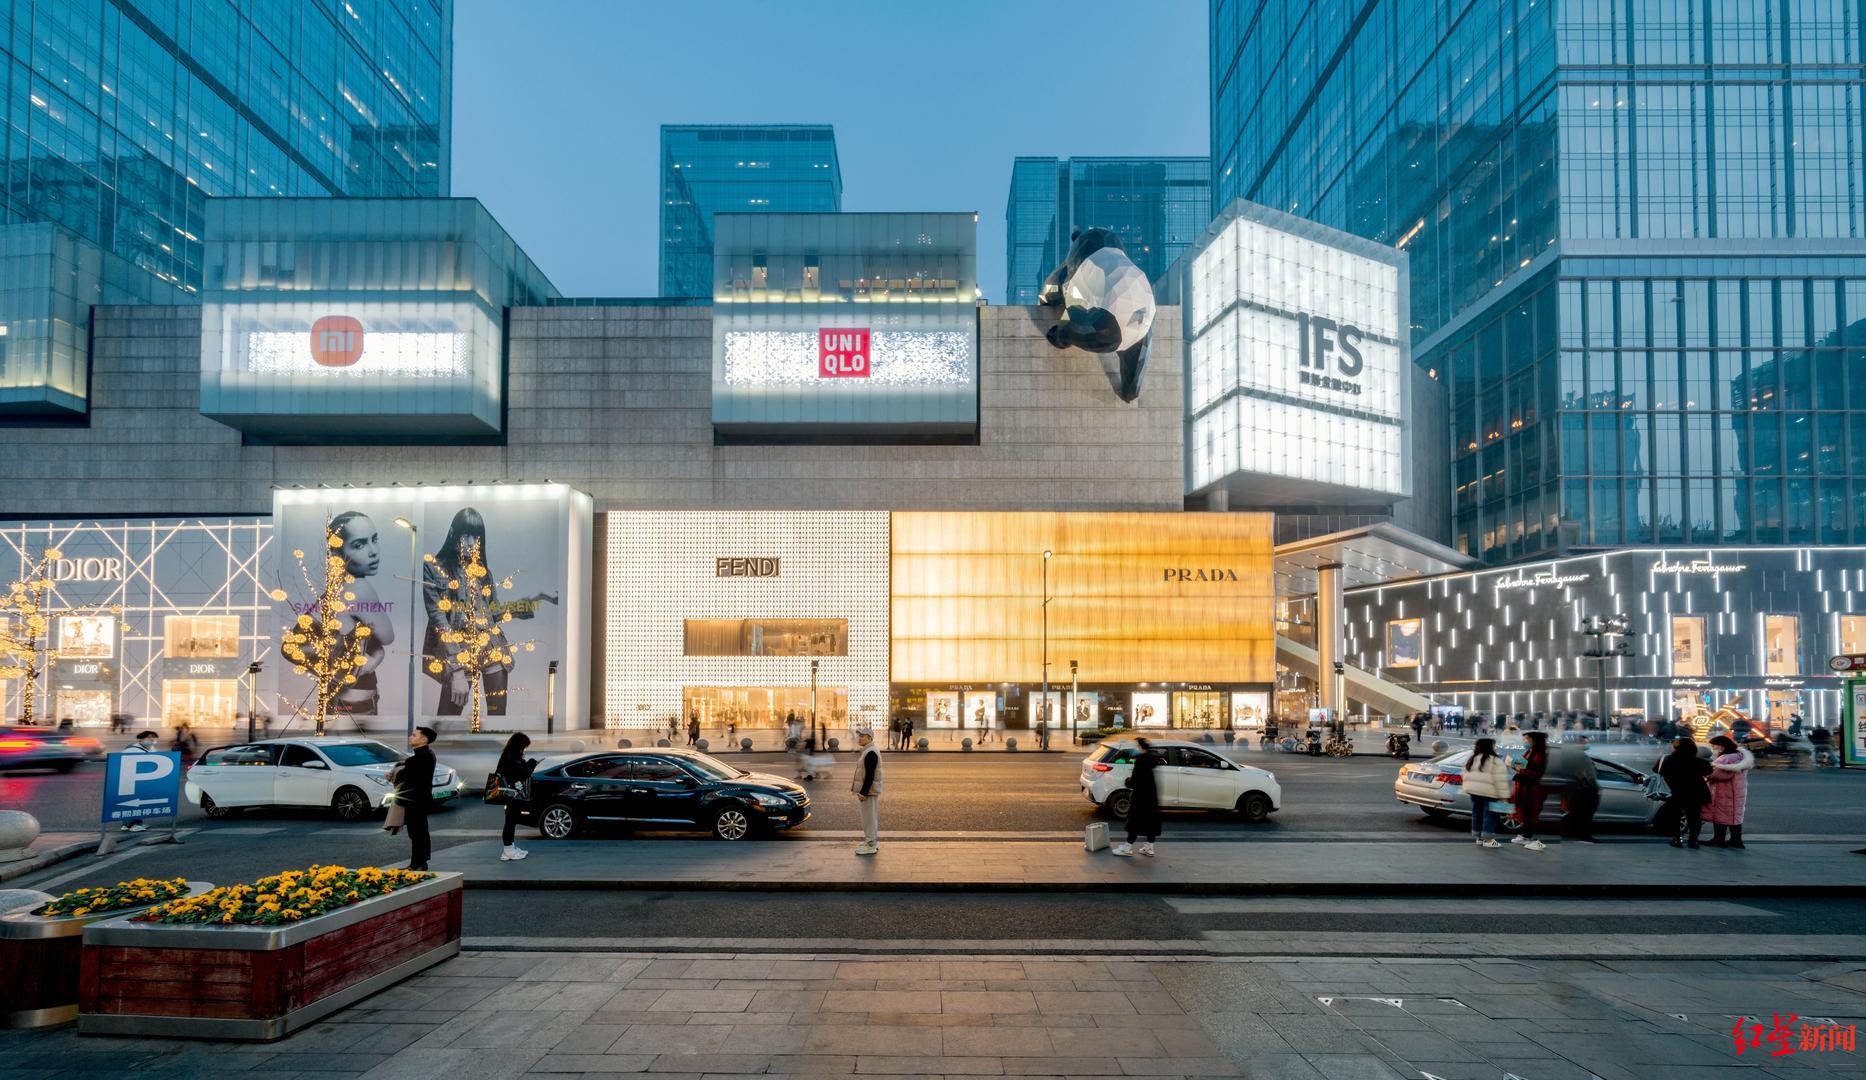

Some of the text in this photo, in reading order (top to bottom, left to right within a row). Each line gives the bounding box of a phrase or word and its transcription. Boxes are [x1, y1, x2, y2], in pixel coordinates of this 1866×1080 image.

[825, 334, 861, 351] UNI
[1298, 312, 1363, 377] IFS
[825, 354, 864, 374] QLO
[53, 558, 121, 581] DIOR
[716, 557, 779, 577] FENDI
[1164, 568, 1238, 581] PRADA
[74, 664, 98, 674] DIOR
[190, 664, 215, 674] DIOR
[118, 754, 174, 796] P
